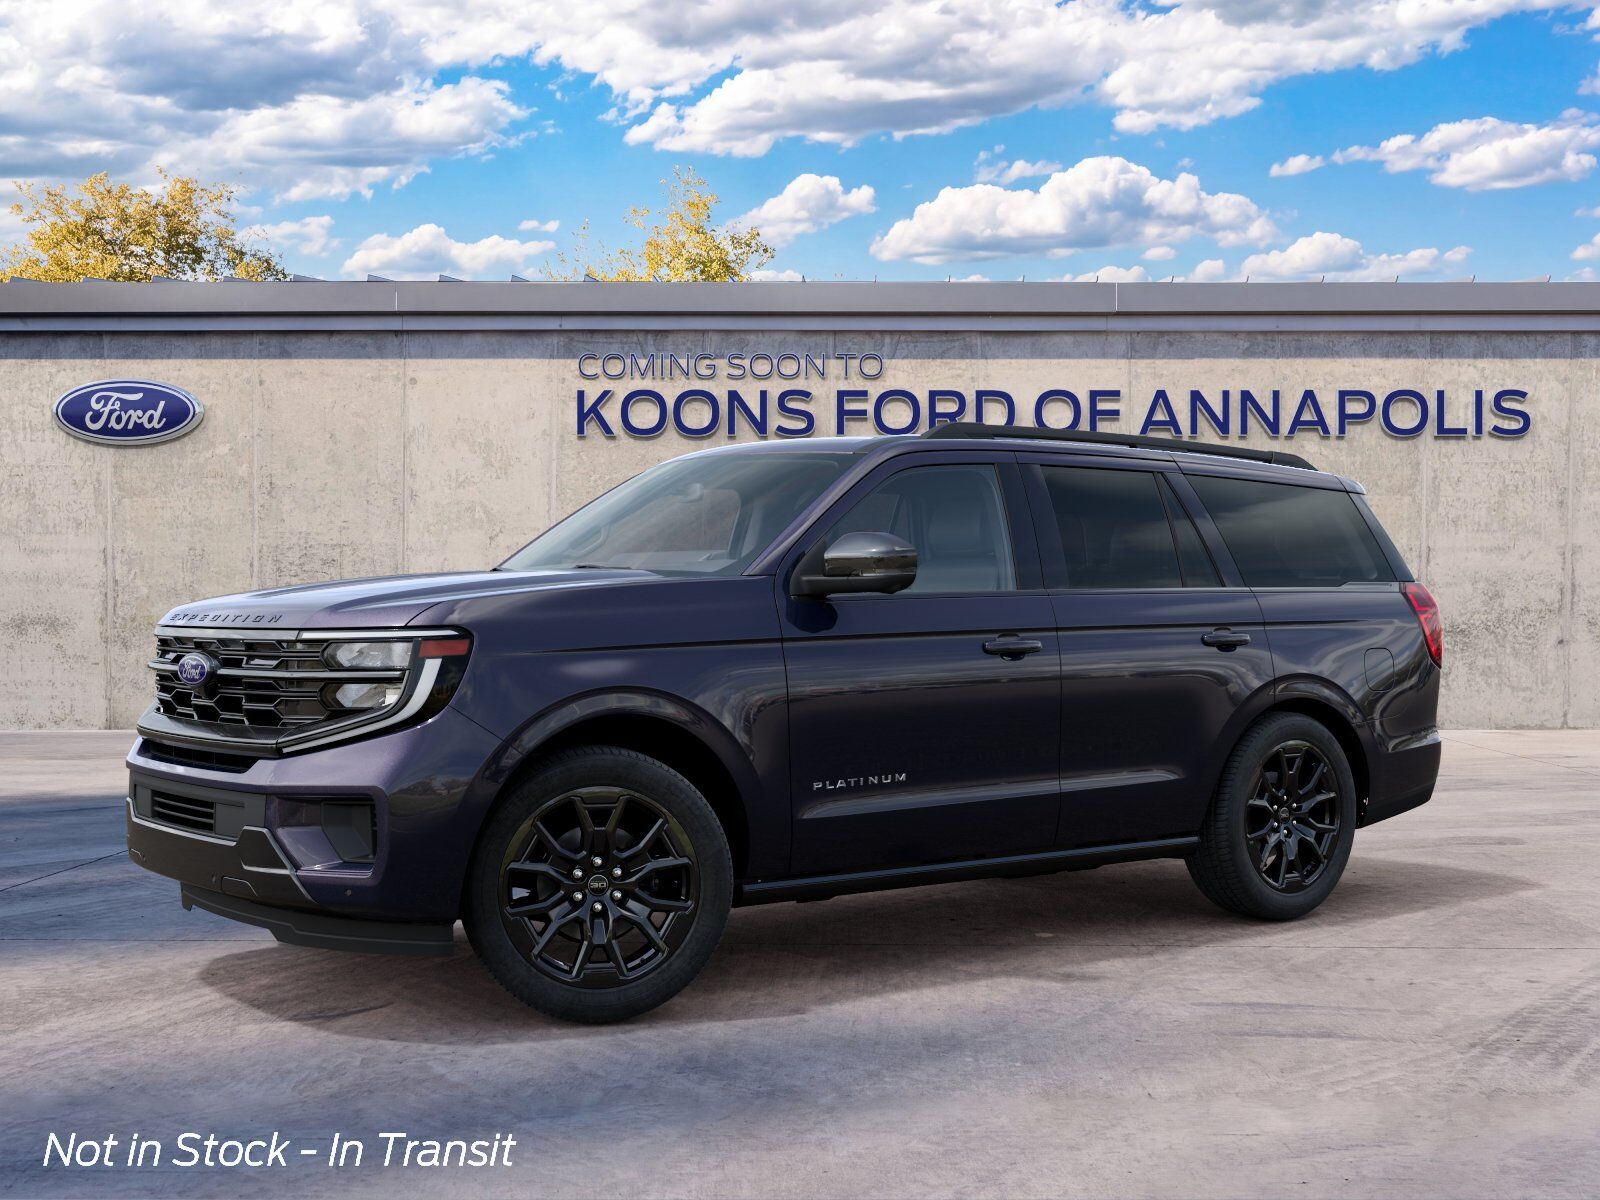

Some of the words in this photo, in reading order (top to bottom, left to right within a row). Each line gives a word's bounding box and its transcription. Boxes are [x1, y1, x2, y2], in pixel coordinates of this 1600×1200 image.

[578, 353, 716, 380] COMING
[726, 353, 826, 380] SOON
[832, 353, 884, 380] TO
[84, 391, 167, 431] Ford
[576, 389, 816, 438] KOONS
[836, 389, 1016, 436] FORD
[1033, 389, 1122, 432] OF
[1139, 389, 1532, 438] ANNAPOLIS
[169, 613, 284, 624] EXPEDITION
[182, 659, 203, 680] Ford
[812, 773, 907, 790] PLATINUM
